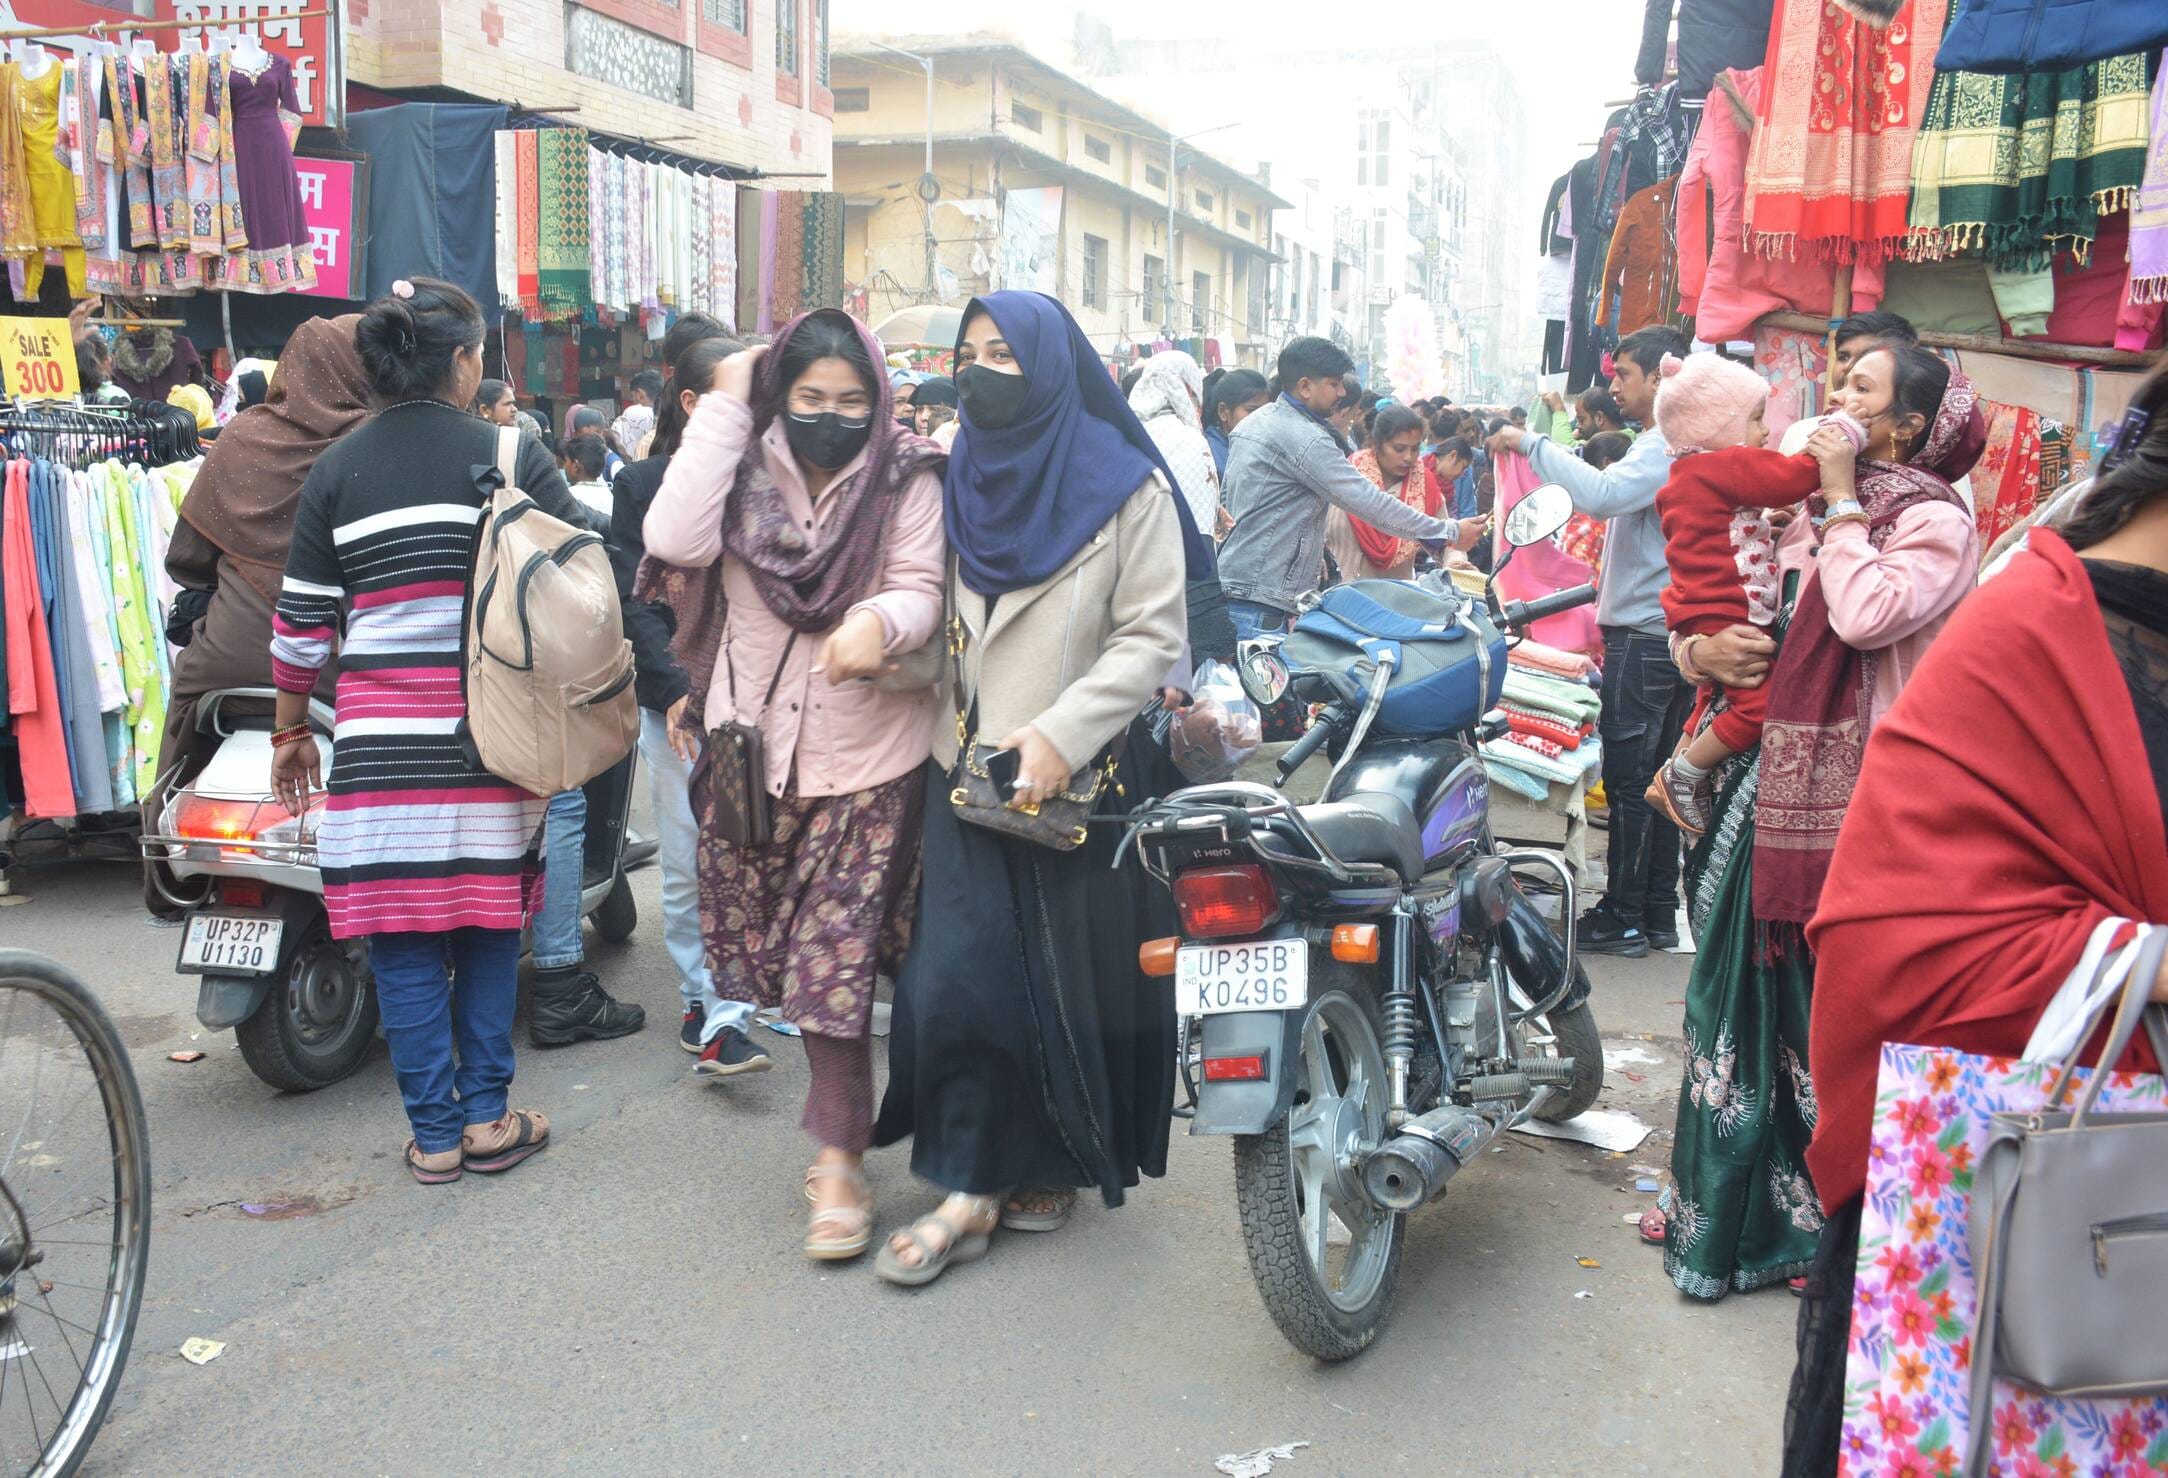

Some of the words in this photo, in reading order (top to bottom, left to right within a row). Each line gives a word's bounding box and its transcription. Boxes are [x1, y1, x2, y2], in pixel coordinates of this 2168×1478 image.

[19, 334, 52, 357] SALE
[16, 360, 64, 394] 300
[206, 919, 270, 943] UP32P
[201, 942, 263, 966] U1130
[1199, 945, 1288, 976] UP35B
[1182, 976, 1197, 985] IND
[1199, 977, 1288, 1009] K0496
